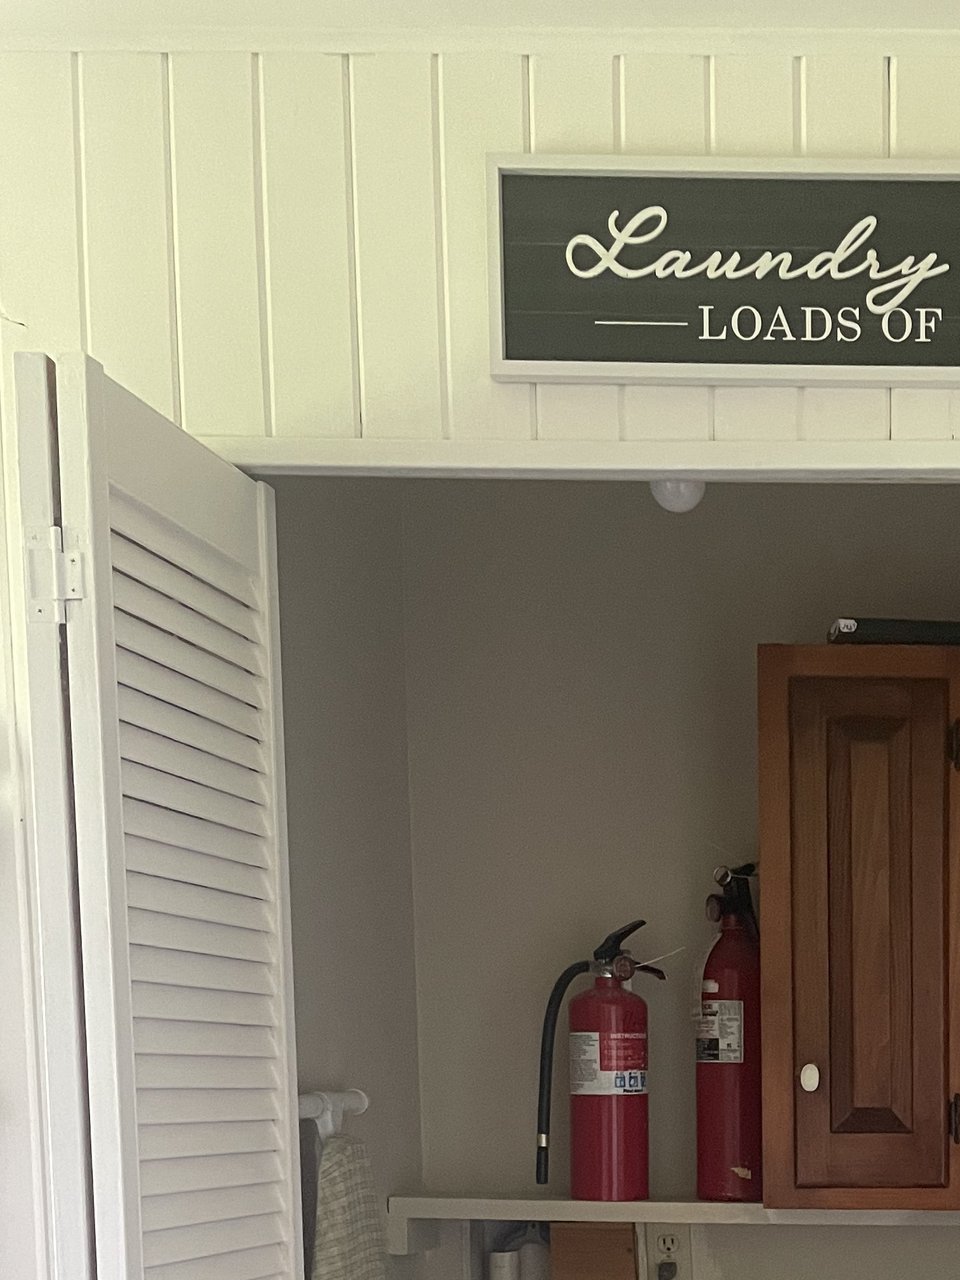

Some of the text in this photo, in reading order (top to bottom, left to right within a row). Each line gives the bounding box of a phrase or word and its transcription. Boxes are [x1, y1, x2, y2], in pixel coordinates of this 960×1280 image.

[566, 205, 949, 314] Laundry
[698, 305, 862, 343] LOADS
[881, 308, 943, 344] OF
